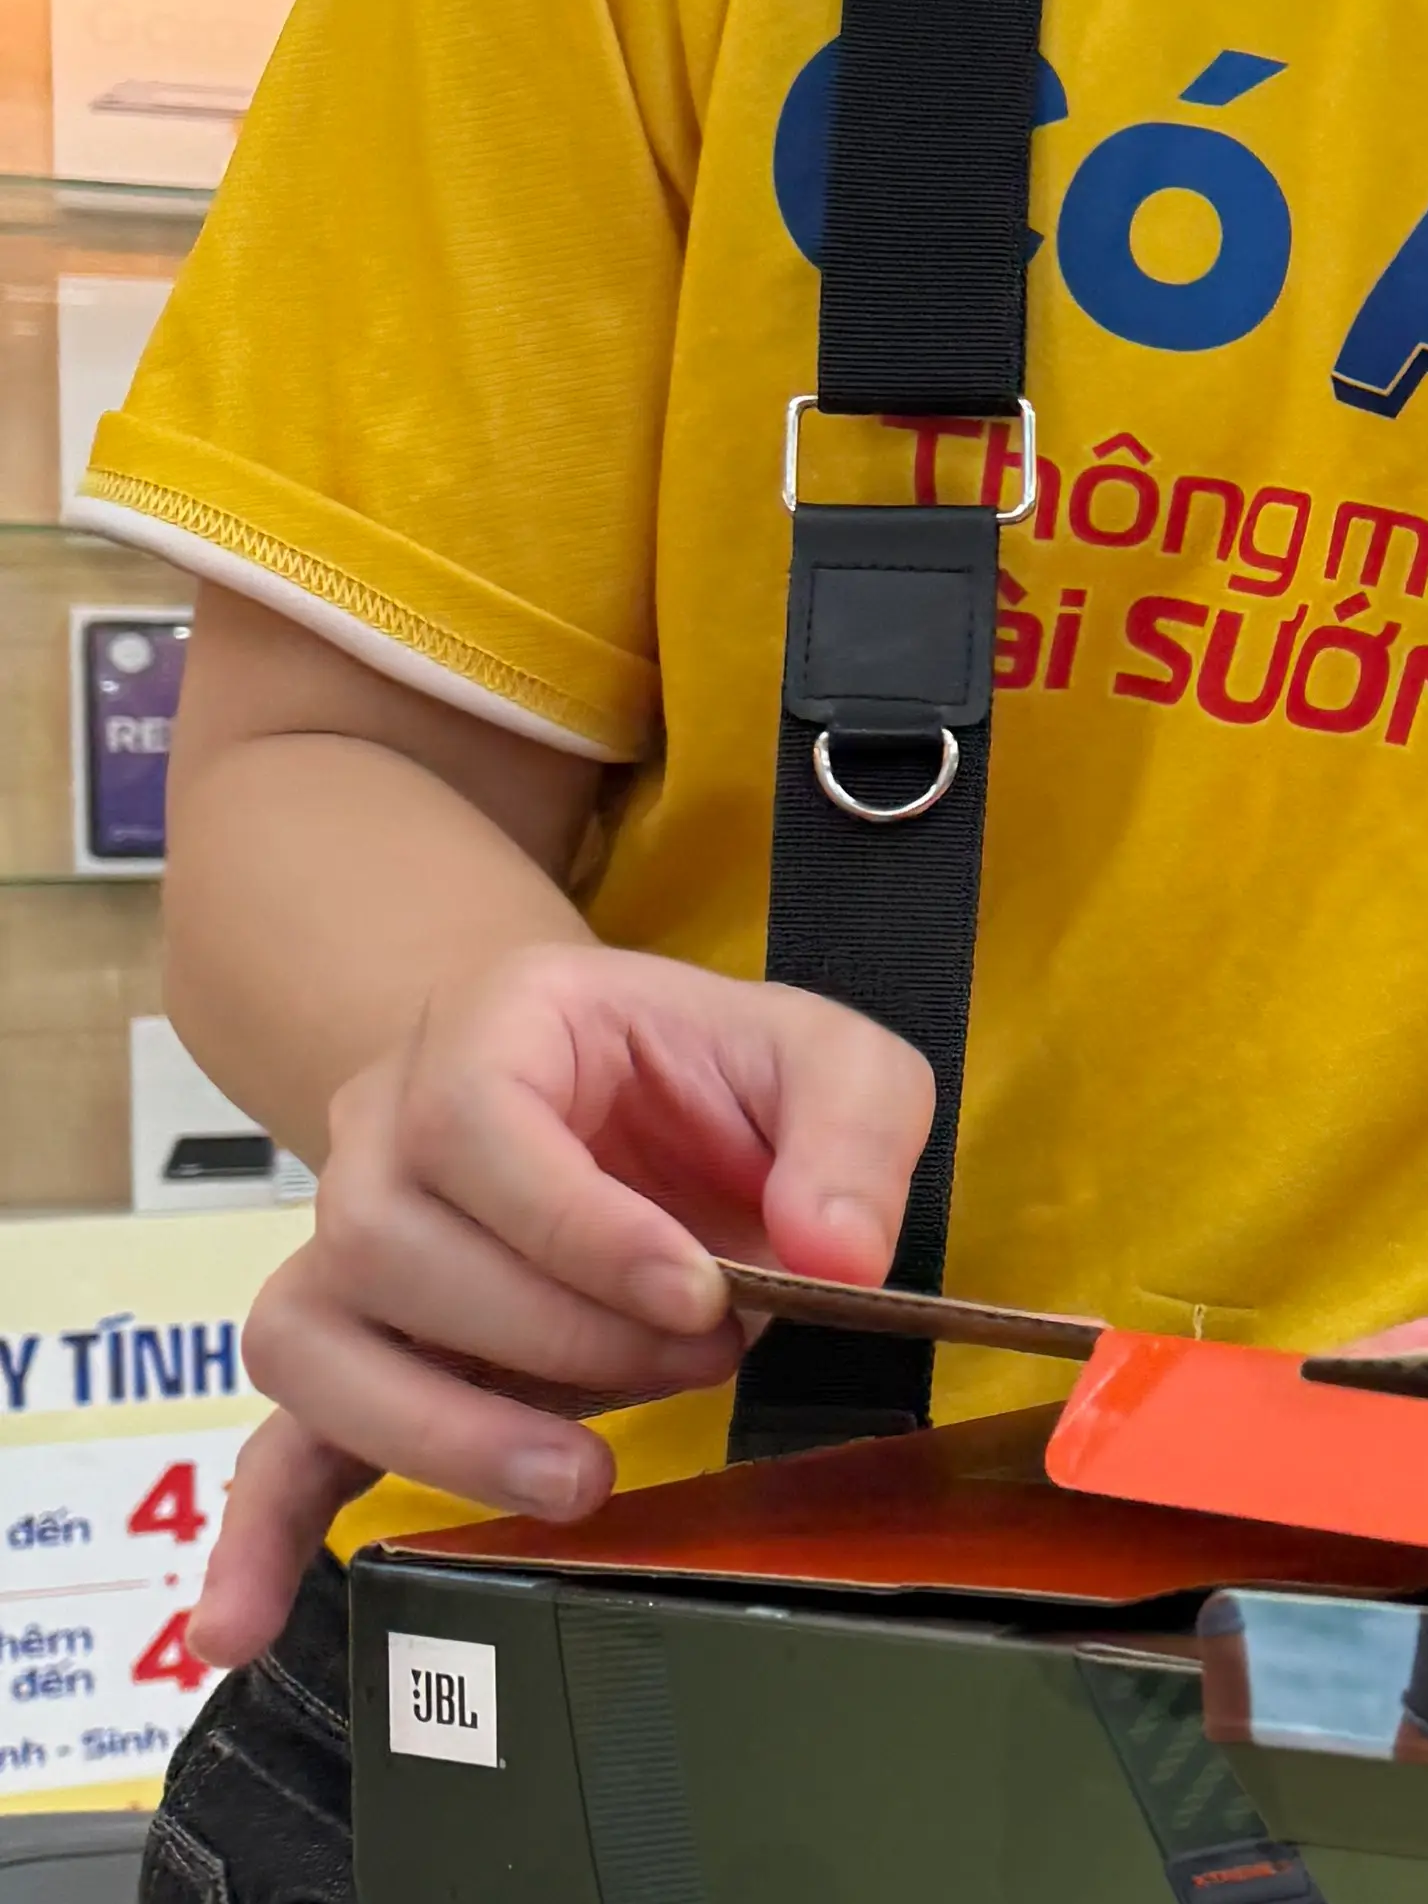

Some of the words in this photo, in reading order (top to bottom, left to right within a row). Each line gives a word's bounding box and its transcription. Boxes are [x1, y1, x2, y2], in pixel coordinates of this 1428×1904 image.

[994, 567, 1087, 691] ài
[62, 1312, 239, 1406] TÍNH
[7, 1511, 92, 1552] đến
[126, 1460, 208, 1545] 4
[10, 1657, 95, 1701] đến
[131, 1608, 210, 1693] 4
[411, 1667, 479, 1730] JBL
